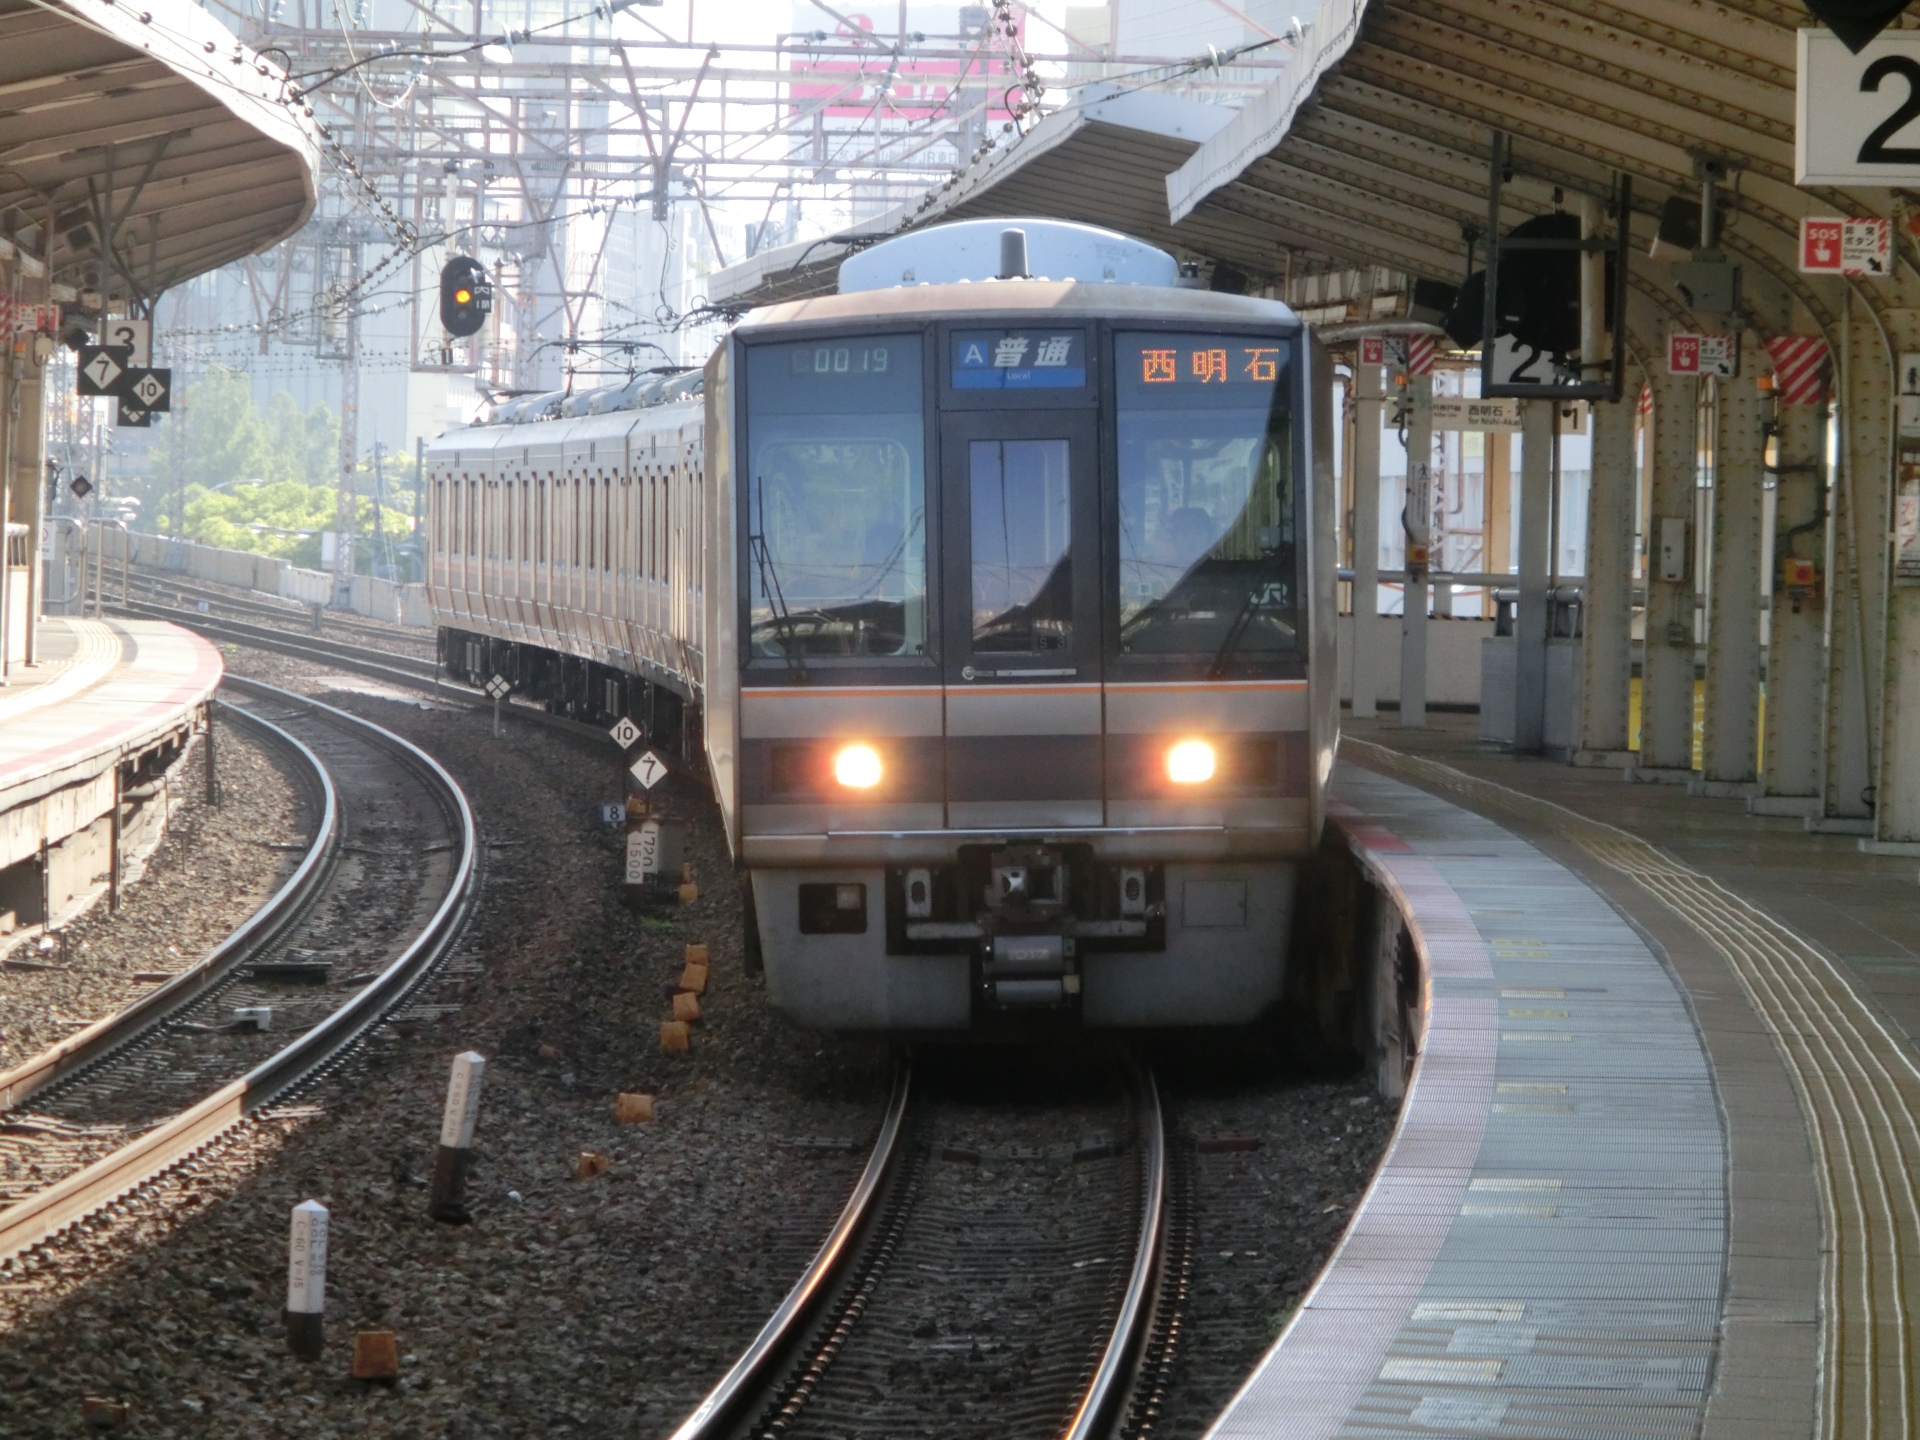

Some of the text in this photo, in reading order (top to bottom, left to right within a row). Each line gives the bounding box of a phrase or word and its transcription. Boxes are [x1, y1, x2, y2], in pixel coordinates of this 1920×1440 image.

[1857, 55, 1920, 163] 2
[1808, 228, 1839, 240] SOS
[114, 326, 136, 358] 3
[1364, 341, 1382, 349] SOS
[1674, 341, 1698, 351] SOS
[963, 336, 1074, 368] A 普通
[96, 360, 110, 382] 7
[1141, 348, 1280, 384] 西明石
[1508, 342, 1541, 384] 2
[1006, 370, 1031, 380] Local
[140, 382, 157, 397] 10
[1468, 416, 1479, 425] for
[617, 726, 634, 741] 10
[642, 759, 656, 782] 7
[610, 806, 620, 820] 8
[629, 841, 642, 879] 1500
